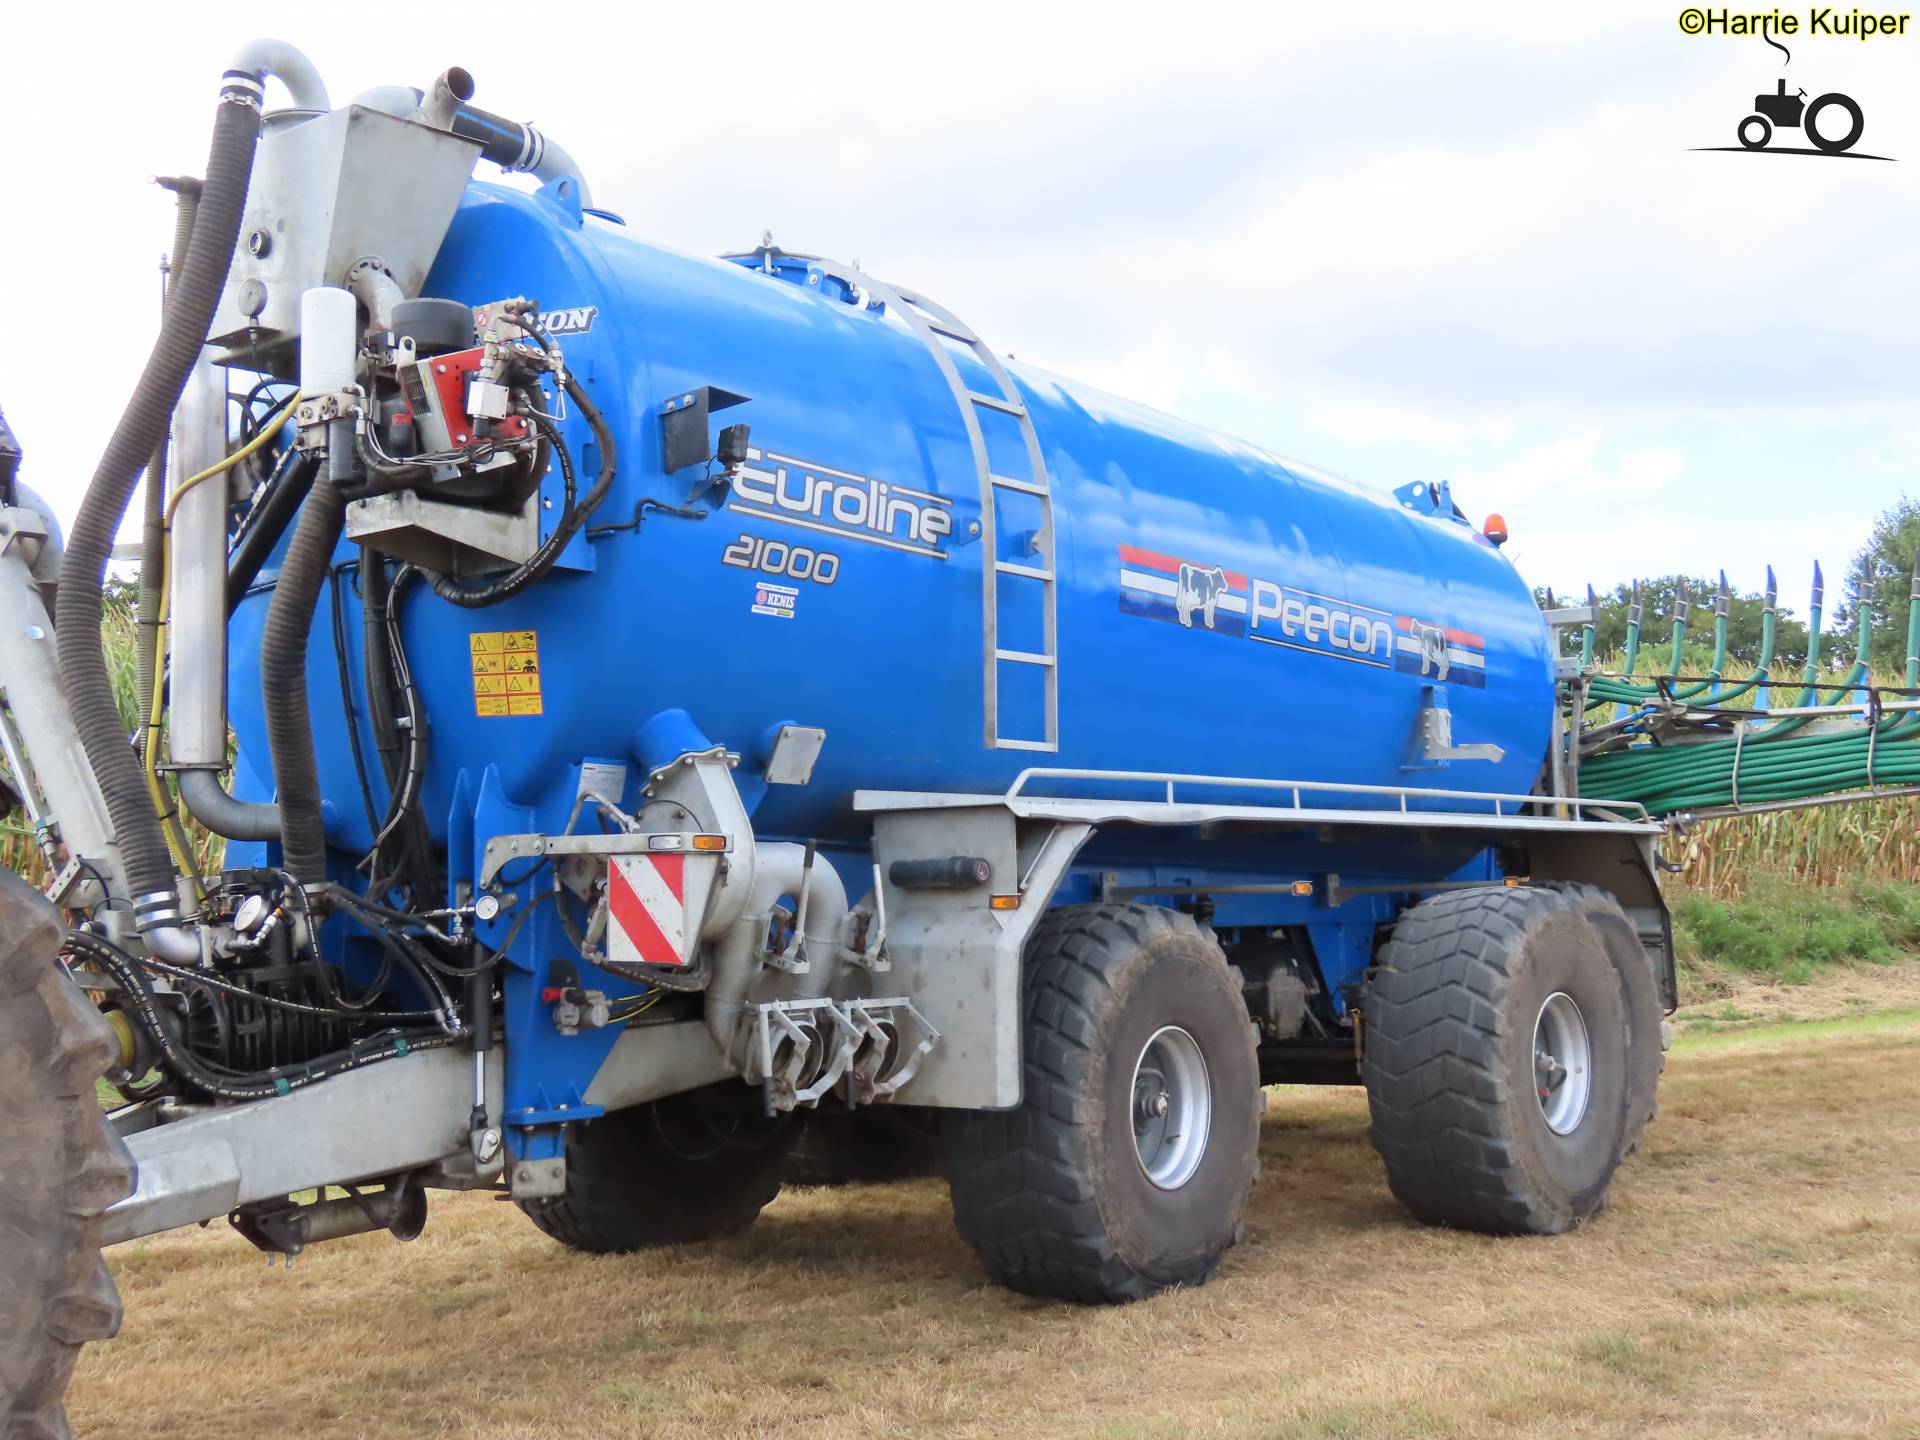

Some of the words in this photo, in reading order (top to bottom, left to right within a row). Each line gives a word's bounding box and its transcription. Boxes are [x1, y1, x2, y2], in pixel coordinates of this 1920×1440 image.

[731, 447, 952, 544] Euroline
[722, 534, 840, 585] 21000
[767, 592, 796, 609] KENIS
[1250, 577, 1393, 660] Peecon
